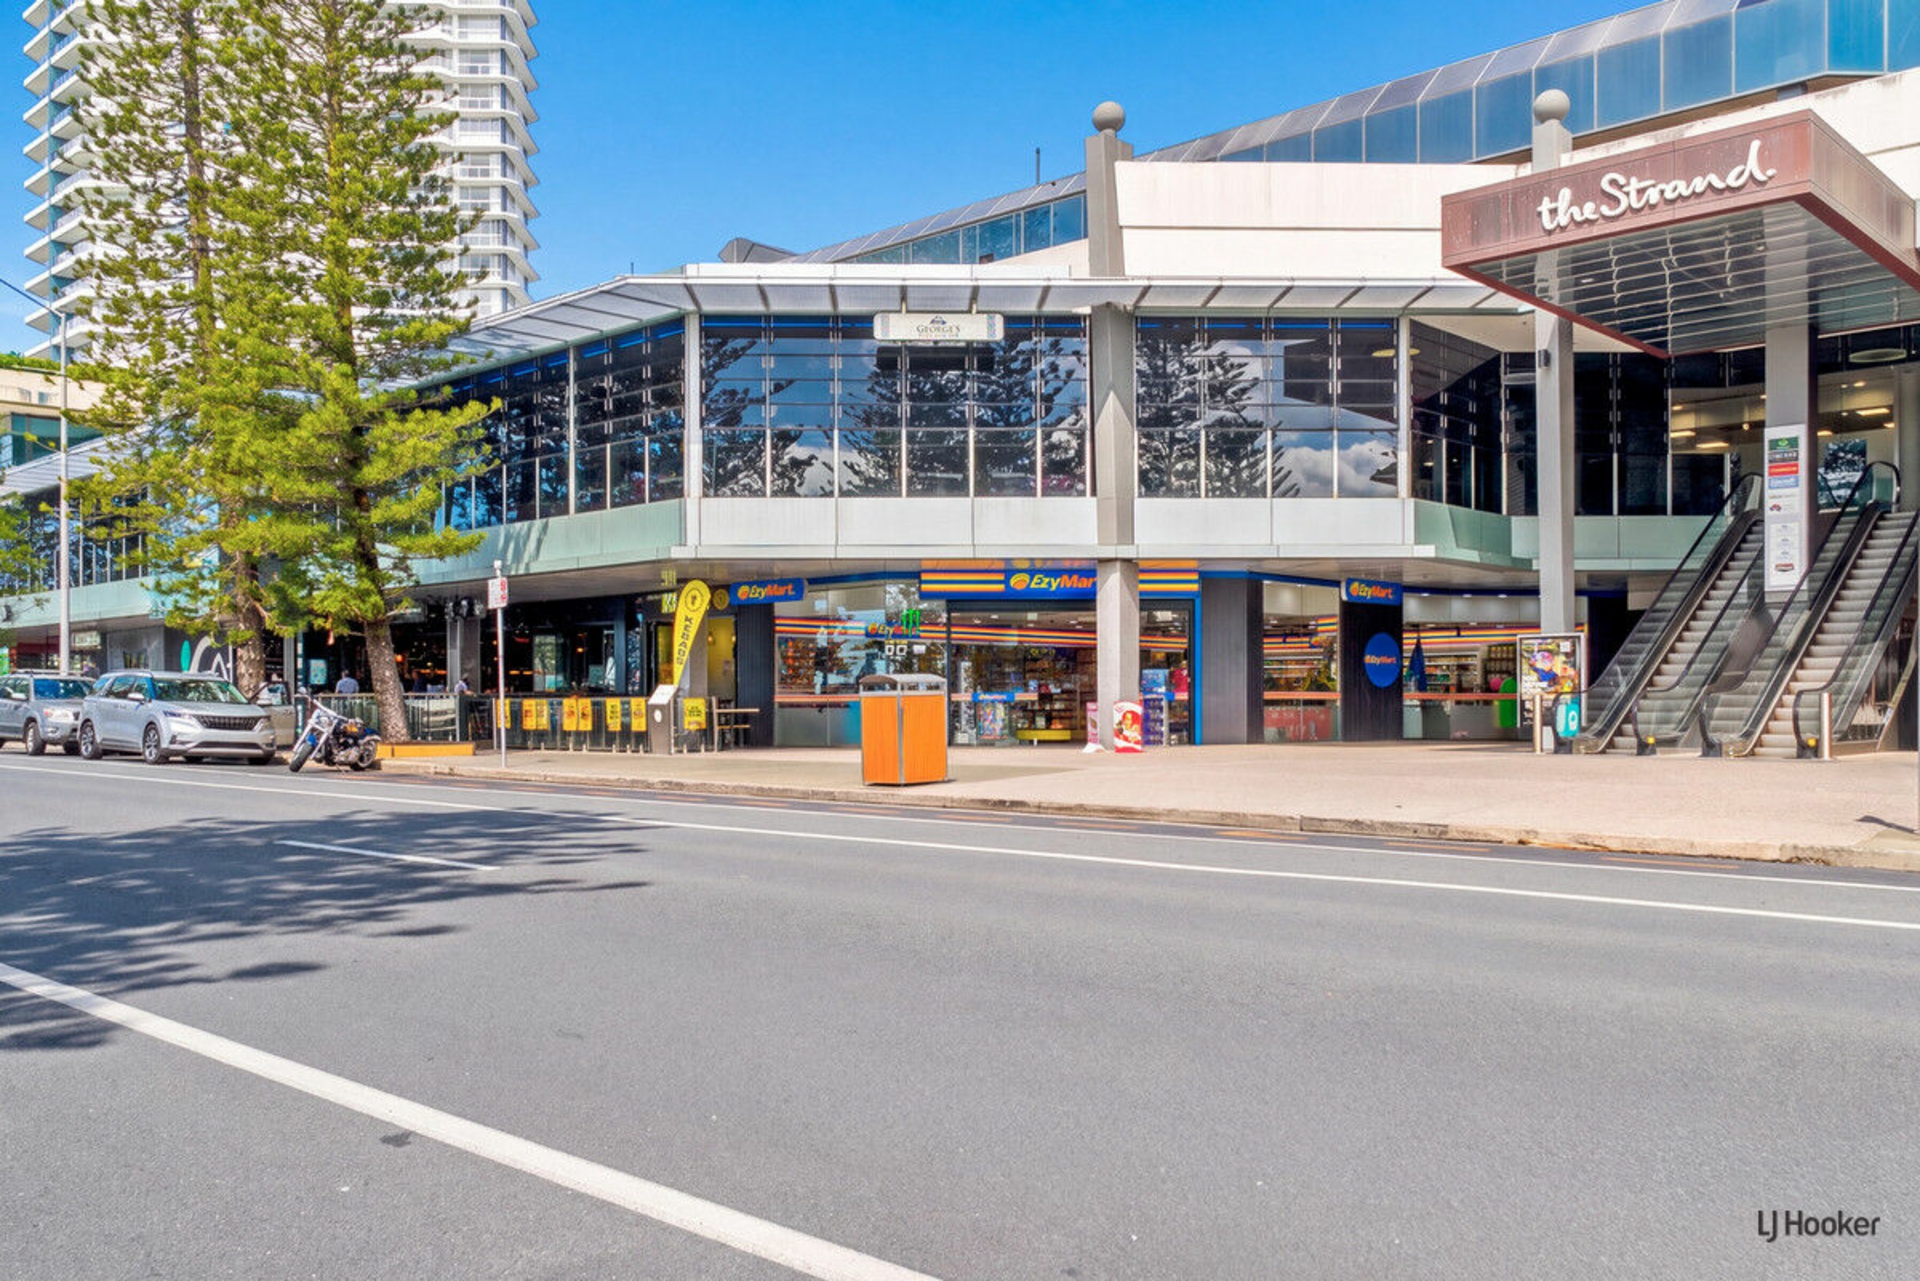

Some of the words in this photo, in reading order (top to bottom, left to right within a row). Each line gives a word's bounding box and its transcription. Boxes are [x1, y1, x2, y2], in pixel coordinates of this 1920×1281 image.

[1537, 187, 1599, 231] the
[1030, 574, 1099, 591] EzyMar
[749, 583, 793, 600] EzyMart
[1359, 584, 1393, 600] EzyMart
